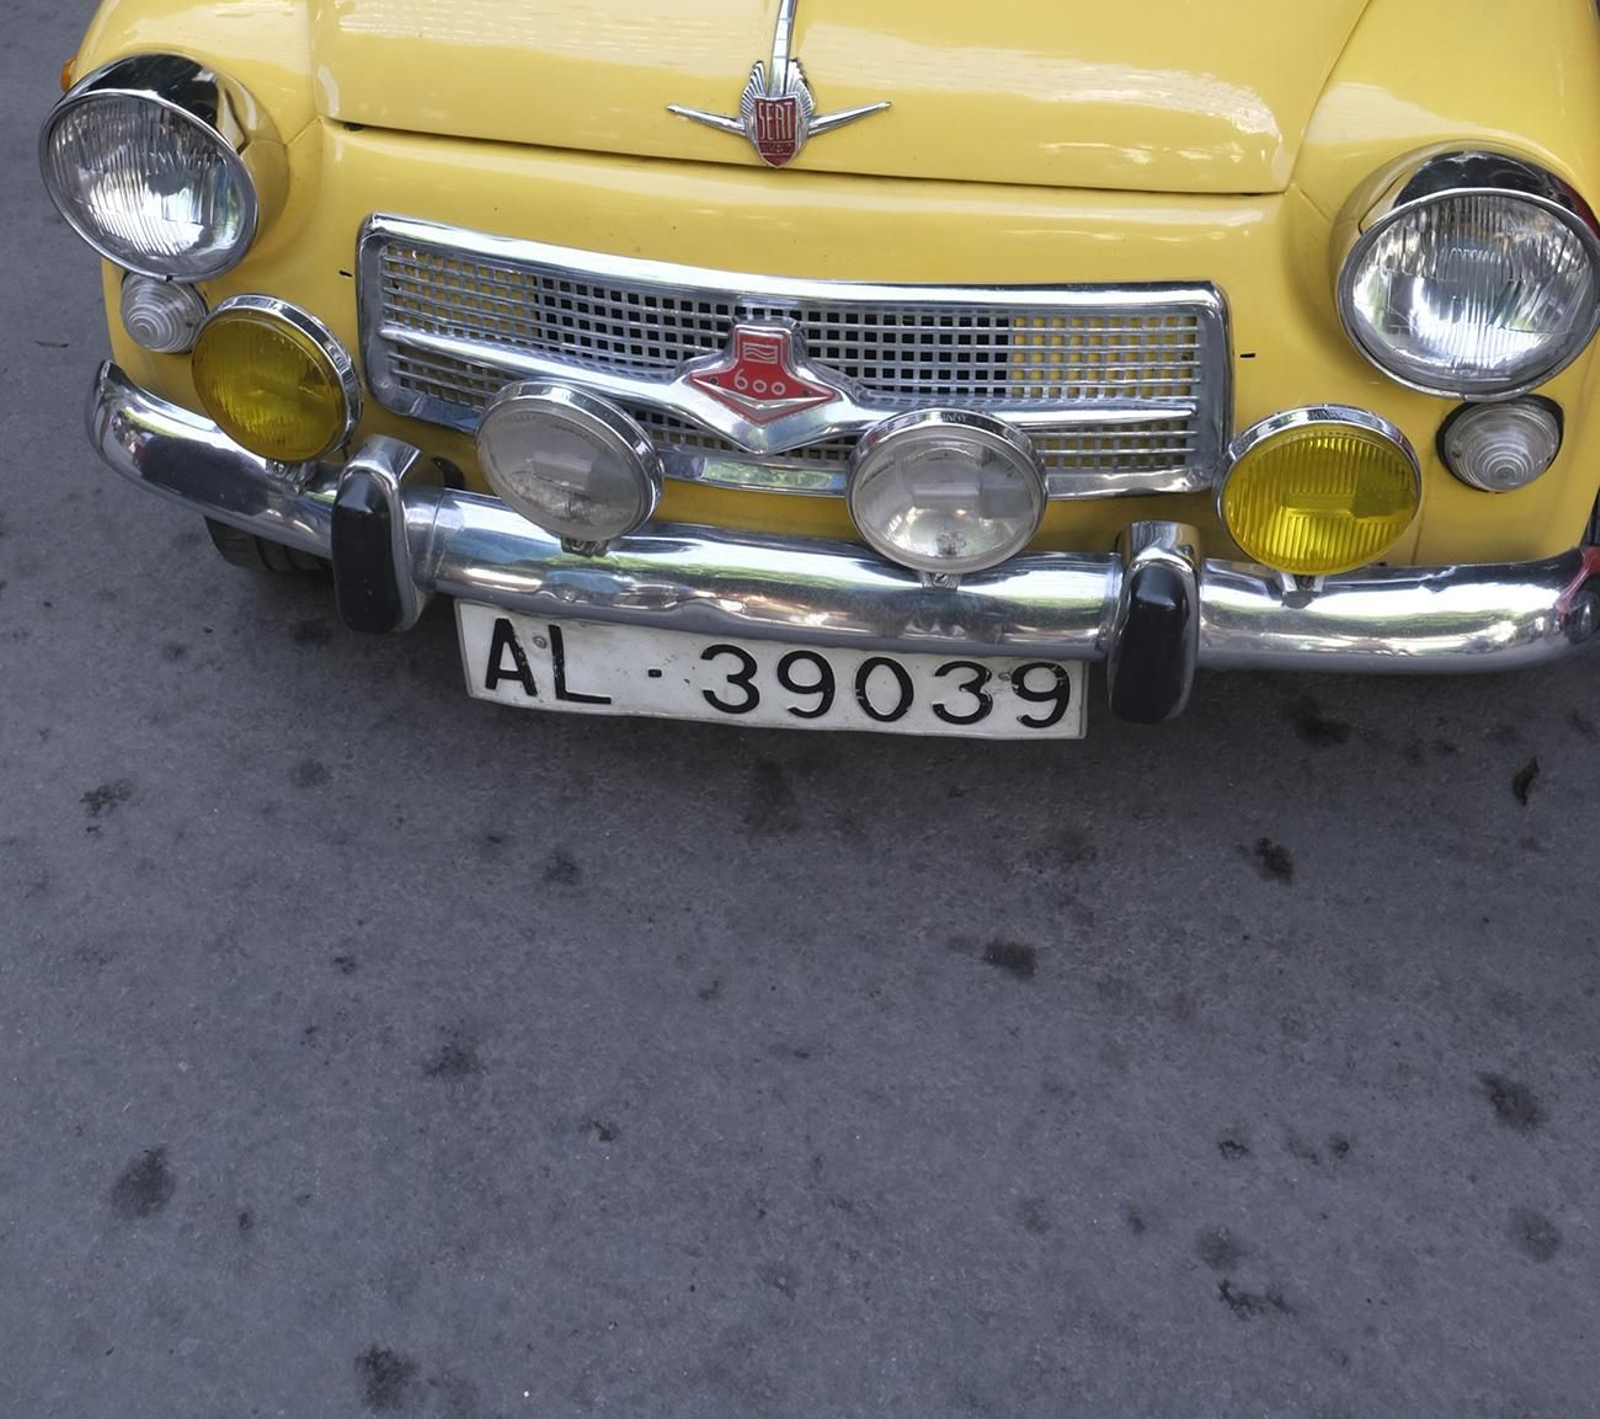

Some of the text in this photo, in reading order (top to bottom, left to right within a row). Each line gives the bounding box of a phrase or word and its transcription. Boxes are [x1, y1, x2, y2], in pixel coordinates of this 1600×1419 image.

[758, 102, 793, 140] SEAT
[734, 368, 787, 395] 600
[485, 617, 612, 706] AL
[702, 643, 1072, 730] 39039
